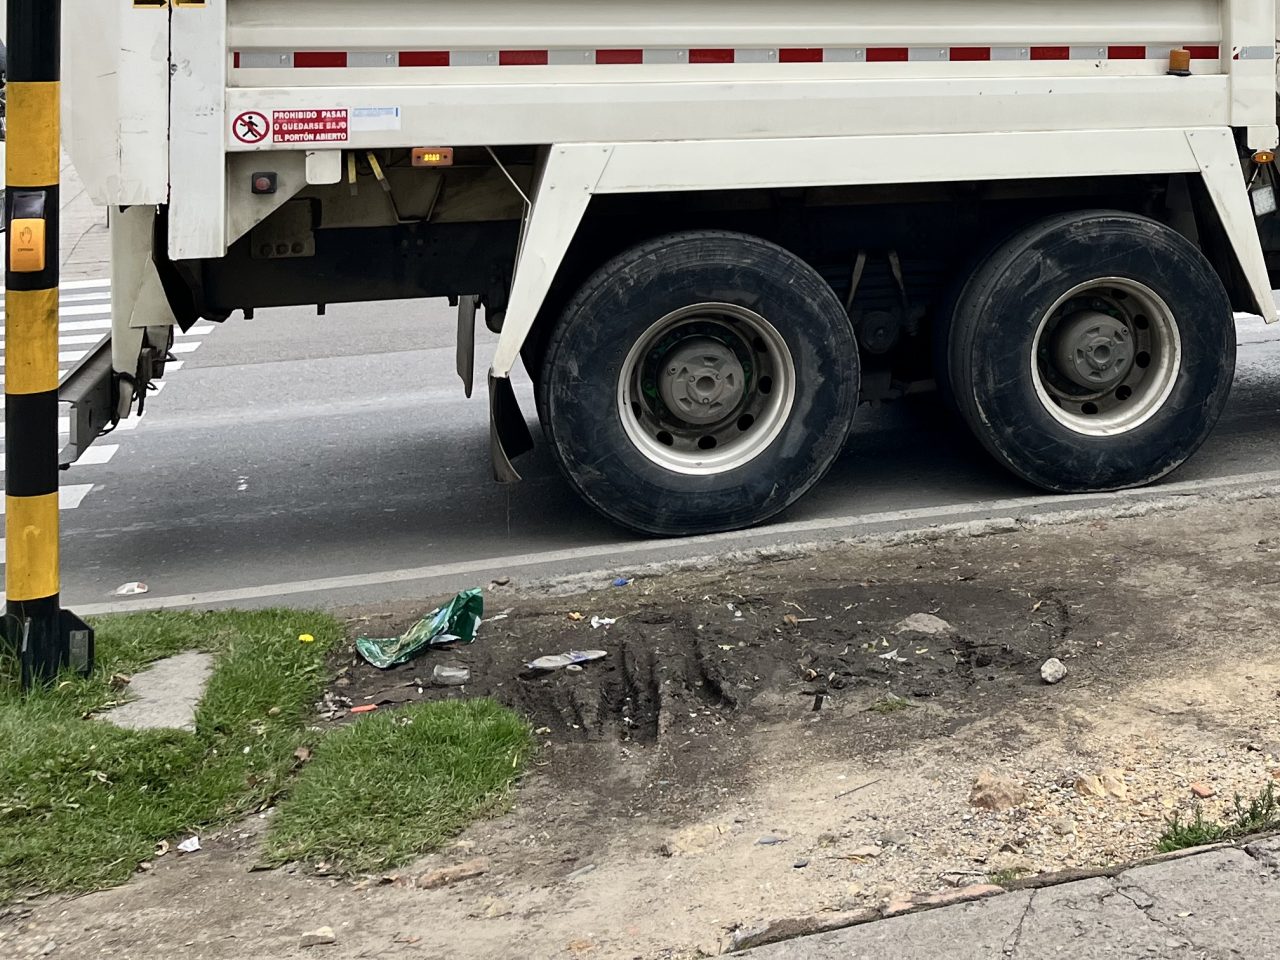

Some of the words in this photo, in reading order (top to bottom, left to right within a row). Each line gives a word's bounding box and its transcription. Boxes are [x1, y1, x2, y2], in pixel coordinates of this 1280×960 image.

[273, 111, 317, 120] PROHIBIDO
[321, 110, 347, 118] PASAR
[274, 123, 279, 131] O
[281, 122, 324, 131] QUEDARSE
[325, 121, 347, 130] BAJO
[273, 134, 283, 142] EL
[284, 132, 313, 141] PORTÓN
[315, 132, 347, 141] ABIERTO
